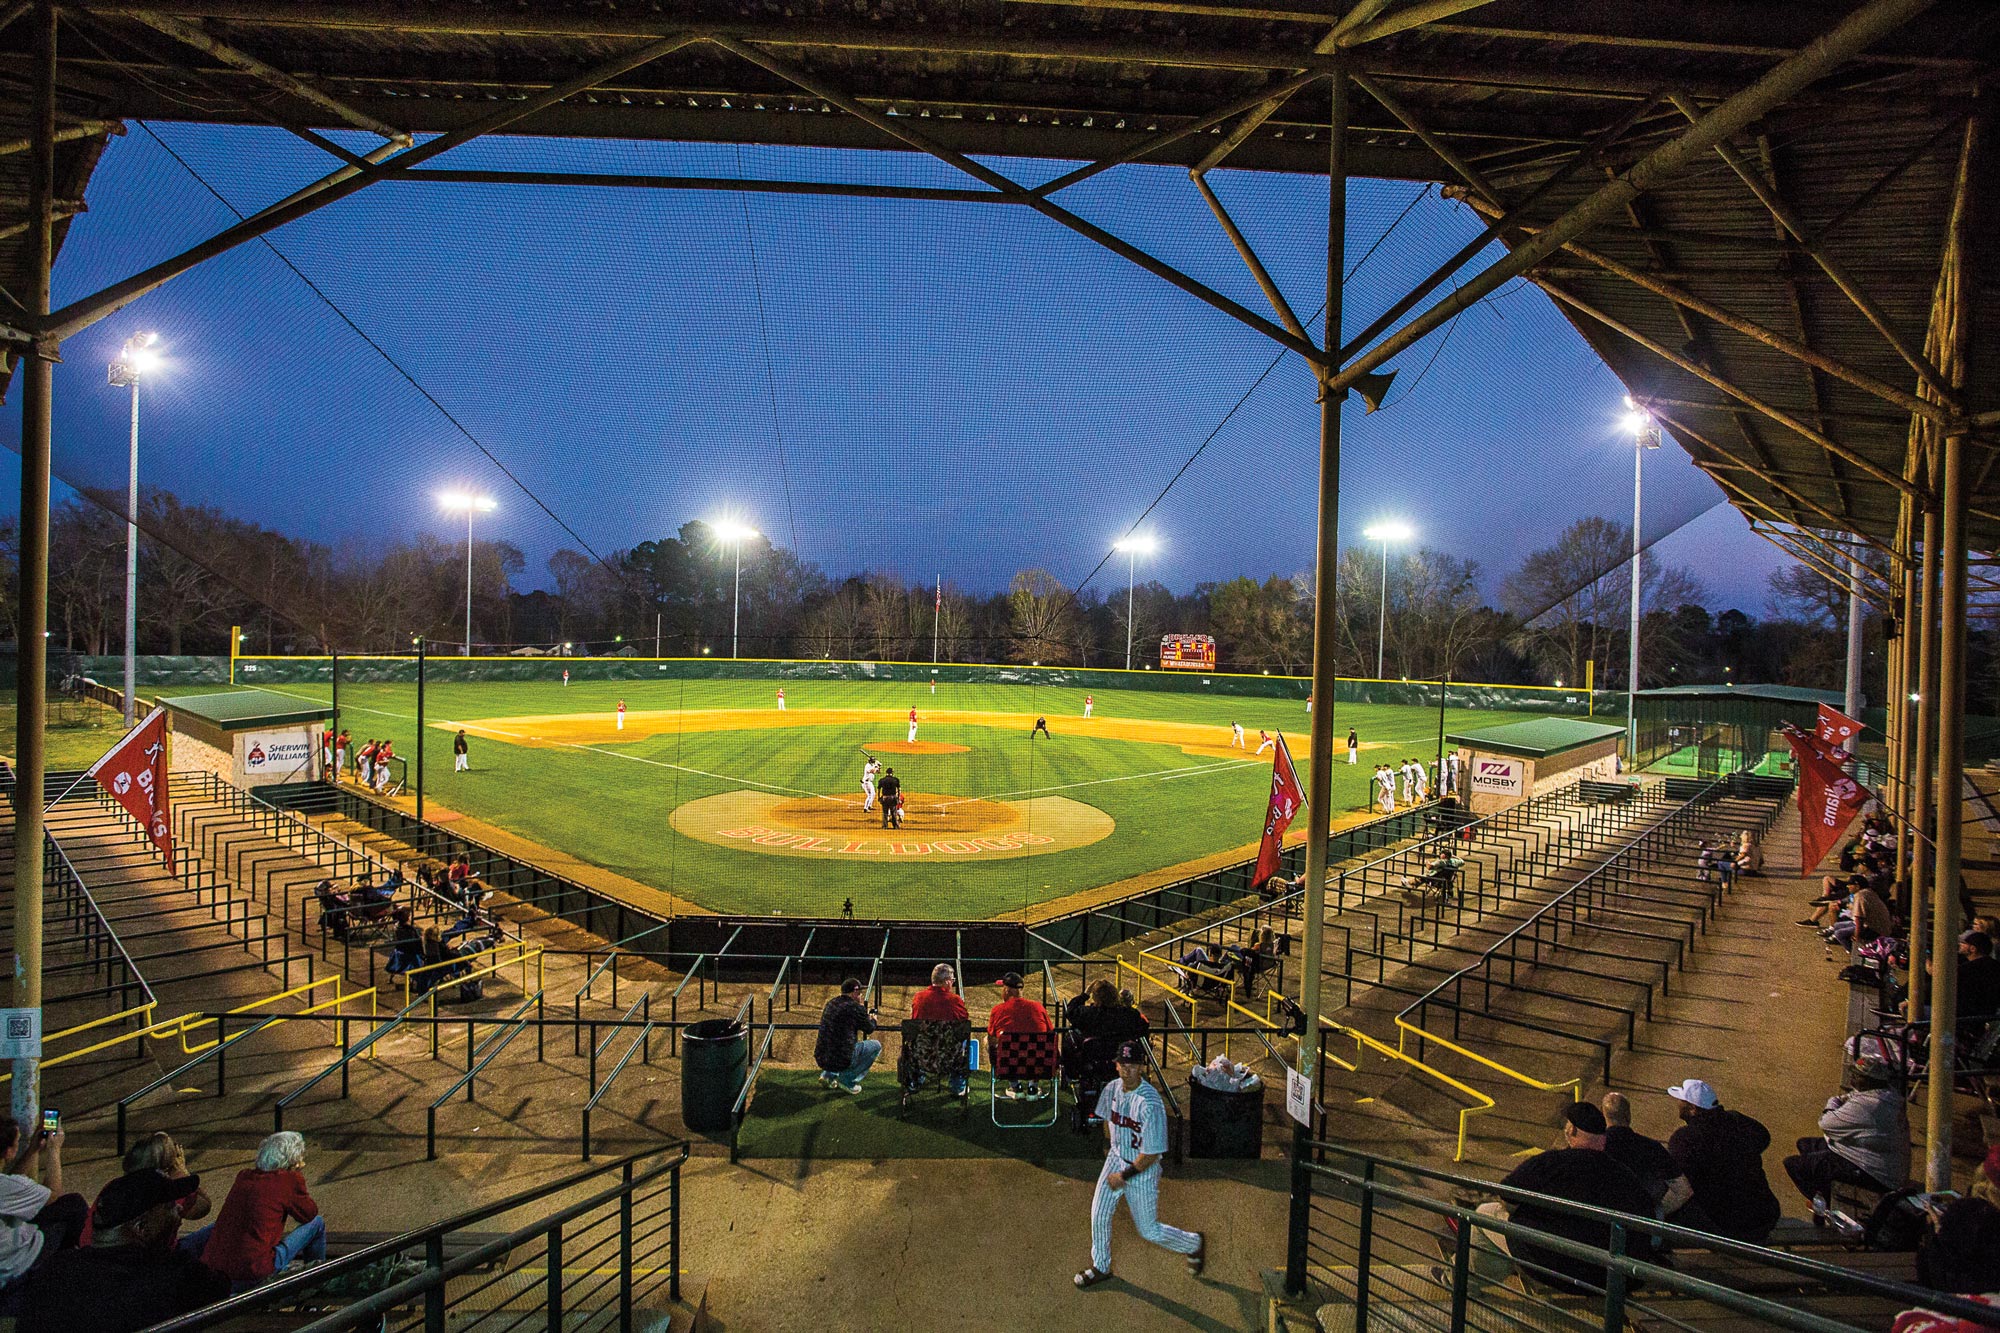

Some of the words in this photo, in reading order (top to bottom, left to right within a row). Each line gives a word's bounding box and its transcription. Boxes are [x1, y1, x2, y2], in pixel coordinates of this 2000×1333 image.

[269, 743, 310, 753] SHERWIN
[268, 752, 311, 761] WILLIAMS
[1473, 775, 1517, 787] MOSBY
[136, 767, 168, 838] Brks
[716, 825, 1055, 855] BULLDOGS
